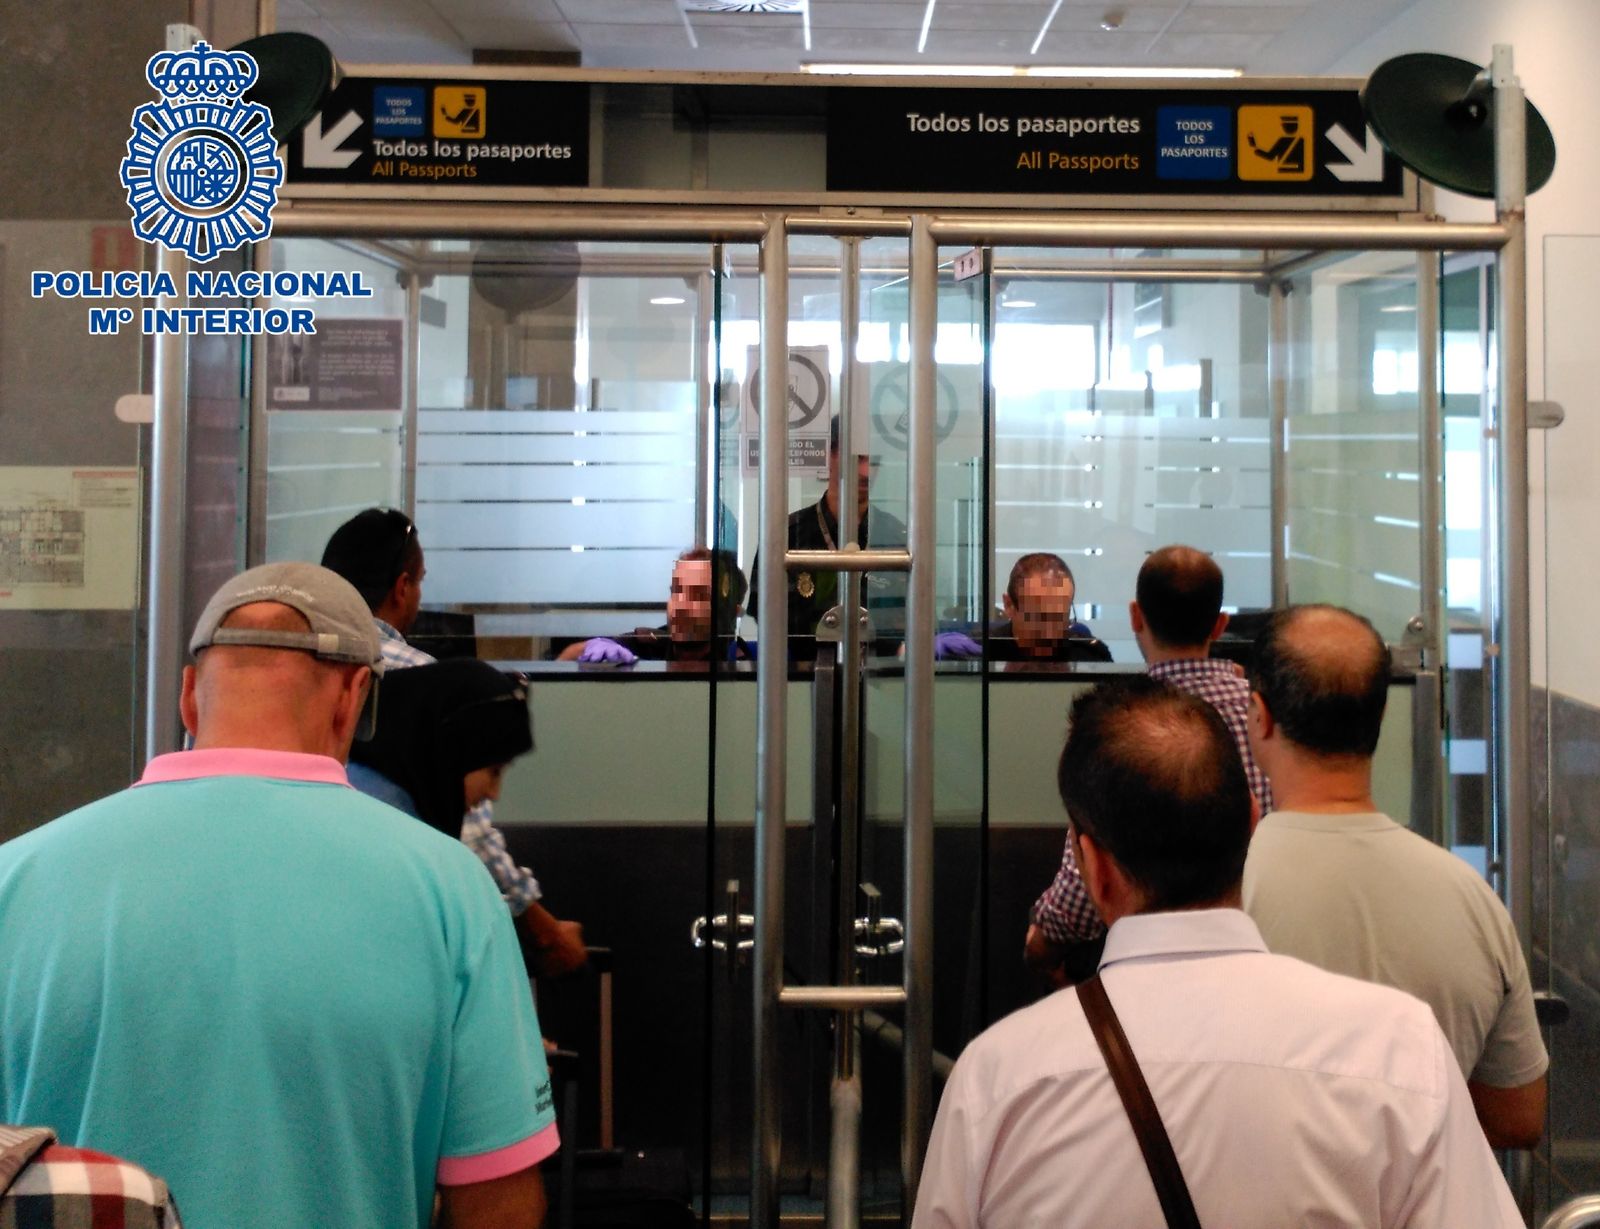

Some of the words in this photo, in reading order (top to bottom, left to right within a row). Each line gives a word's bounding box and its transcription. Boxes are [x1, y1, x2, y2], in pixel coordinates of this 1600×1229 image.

[386, 99, 412, 107] TODOS
[375, 116, 423, 126] PASAPORTES
[907, 113, 971, 133] Todos
[978, 113, 1010, 133] los
[1016, 115, 1141, 138] pasaportes
[1176, 121, 1213, 131] TODOS
[1184, 134, 1206, 144] LOS
[372, 140, 428, 157] Todos
[434, 140, 461, 158] los
[467, 142, 572, 161] pasaportes
[1160, 147, 1228, 158] PASAPORTES
[1016, 152, 1042, 169] All
[1048, 152, 1140, 174] Passports
[371, 162, 394, 177] All
[399, 162, 478, 180] Passports
